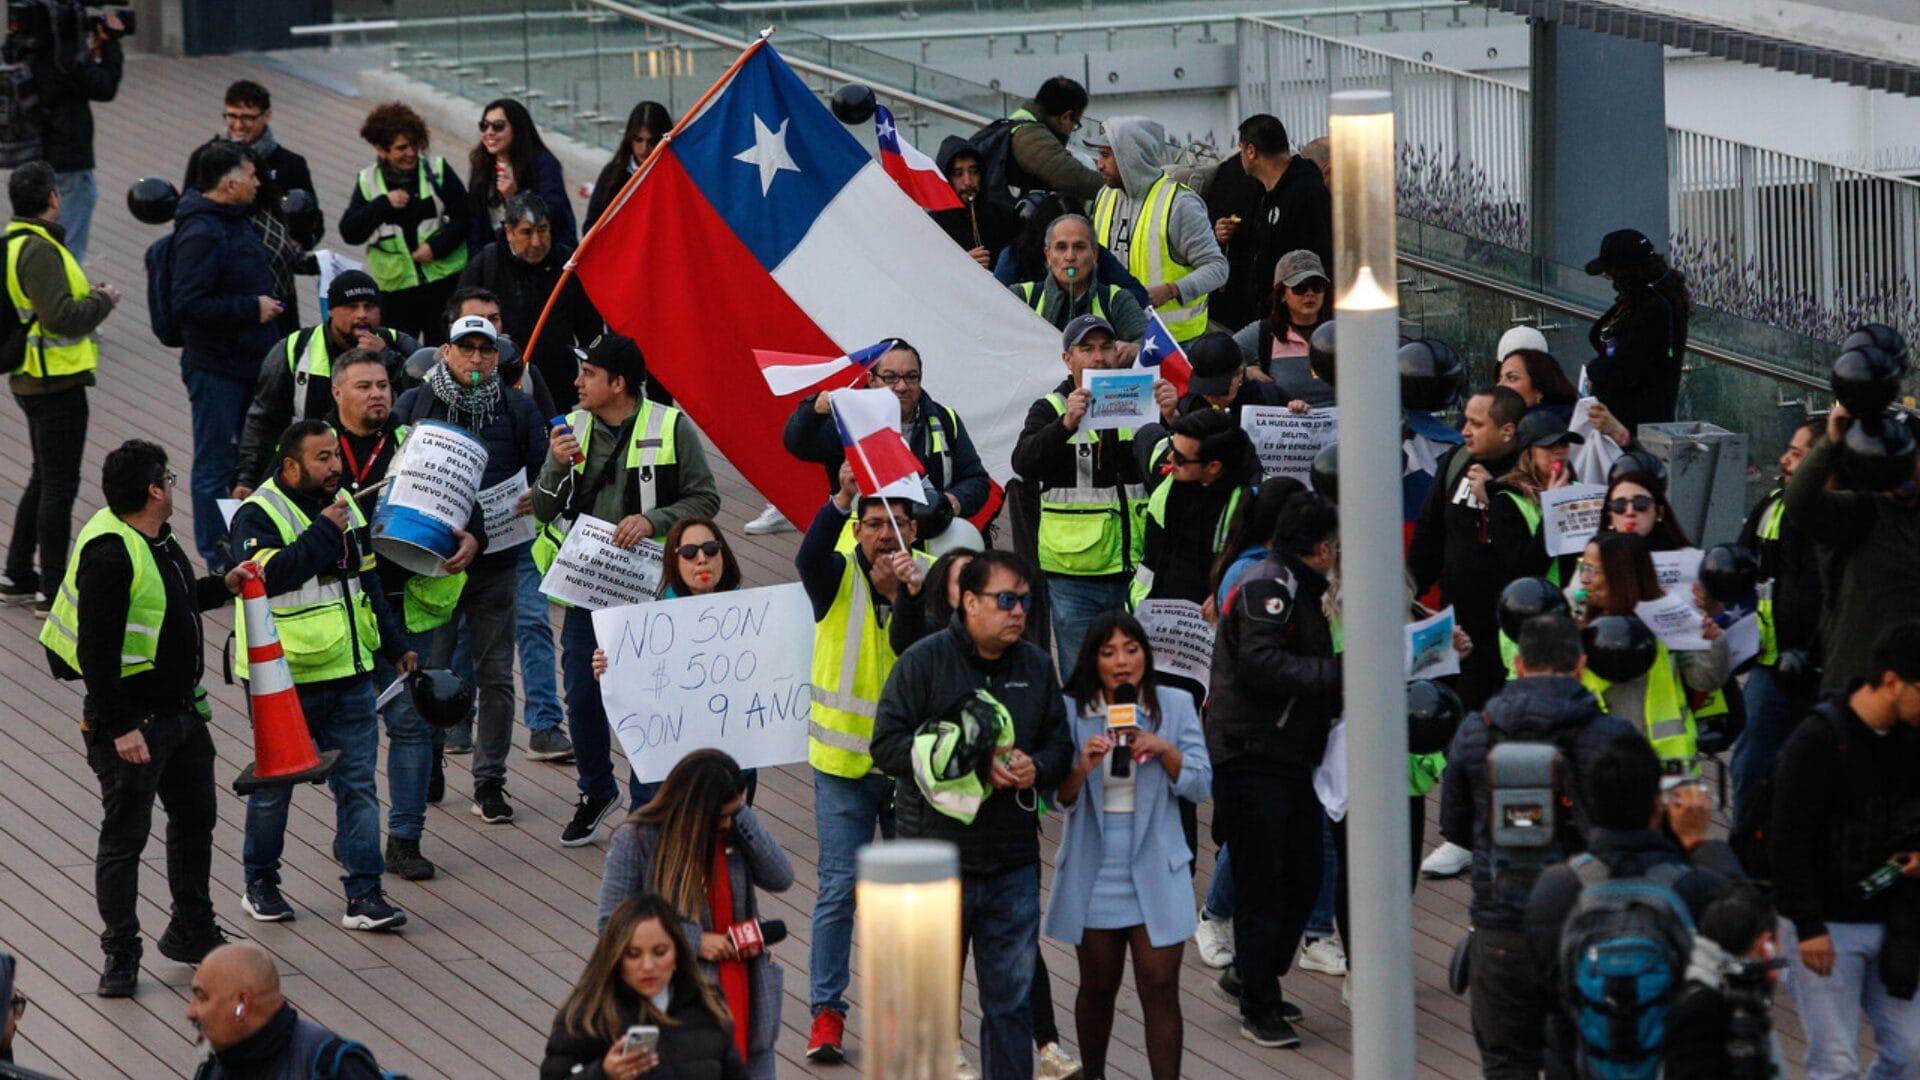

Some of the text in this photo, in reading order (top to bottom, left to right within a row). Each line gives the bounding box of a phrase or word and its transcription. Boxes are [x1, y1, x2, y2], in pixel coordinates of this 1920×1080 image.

[434, 440, 468, 458] HUELGA
[400, 469, 443, 484] SINDICATO
[424, 462, 436, 470] ES
[438, 466, 450, 476] UN
[412, 482, 442, 498] NUEVO
[435, 502, 454, 517] 2024
[638, 550, 649, 558] ES
[651, 553, 663, 562] UN
[556, 558, 596, 577] SINDICATO
[578, 552, 645, 580] ES UN DERECHO
[565, 574, 639, 604] NUEVO PUDAHUEL
[588, 595, 608, 607] 2024
[1164, 610, 1200, 620] HUELGA
[615, 601, 771, 666] NO SON
[1170, 660, 1192, 670] 2024
[617, 706, 684, 755] SON
[708, 693, 728, 738] 9
